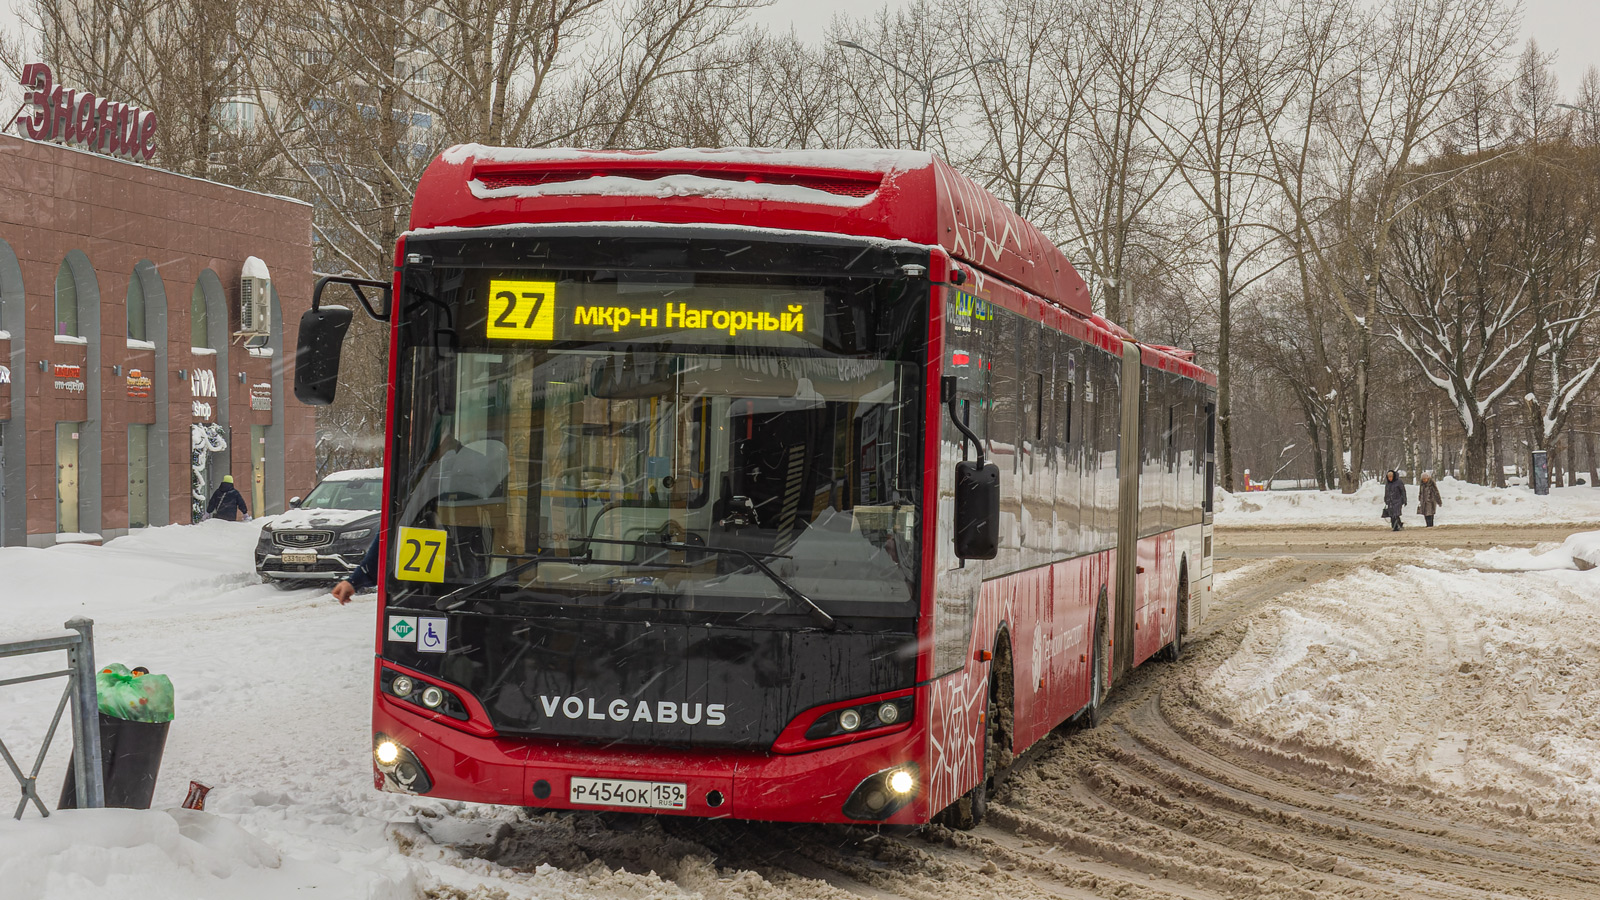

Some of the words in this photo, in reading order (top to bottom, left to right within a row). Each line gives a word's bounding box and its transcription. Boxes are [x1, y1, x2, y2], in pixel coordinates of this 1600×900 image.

[17, 63, 157, 160] Знание
[493, 290, 545, 328] 27
[574, 305, 658, 332] мкр-н
[665, 302, 805, 336] Нагорный
[193, 401, 212, 421] shop
[403, 539, 441, 573] 27
[395, 625, 410, 633] КПГ
[540, 695, 726, 726] VOLGABUS
[653, 785, 681, 801] 159
